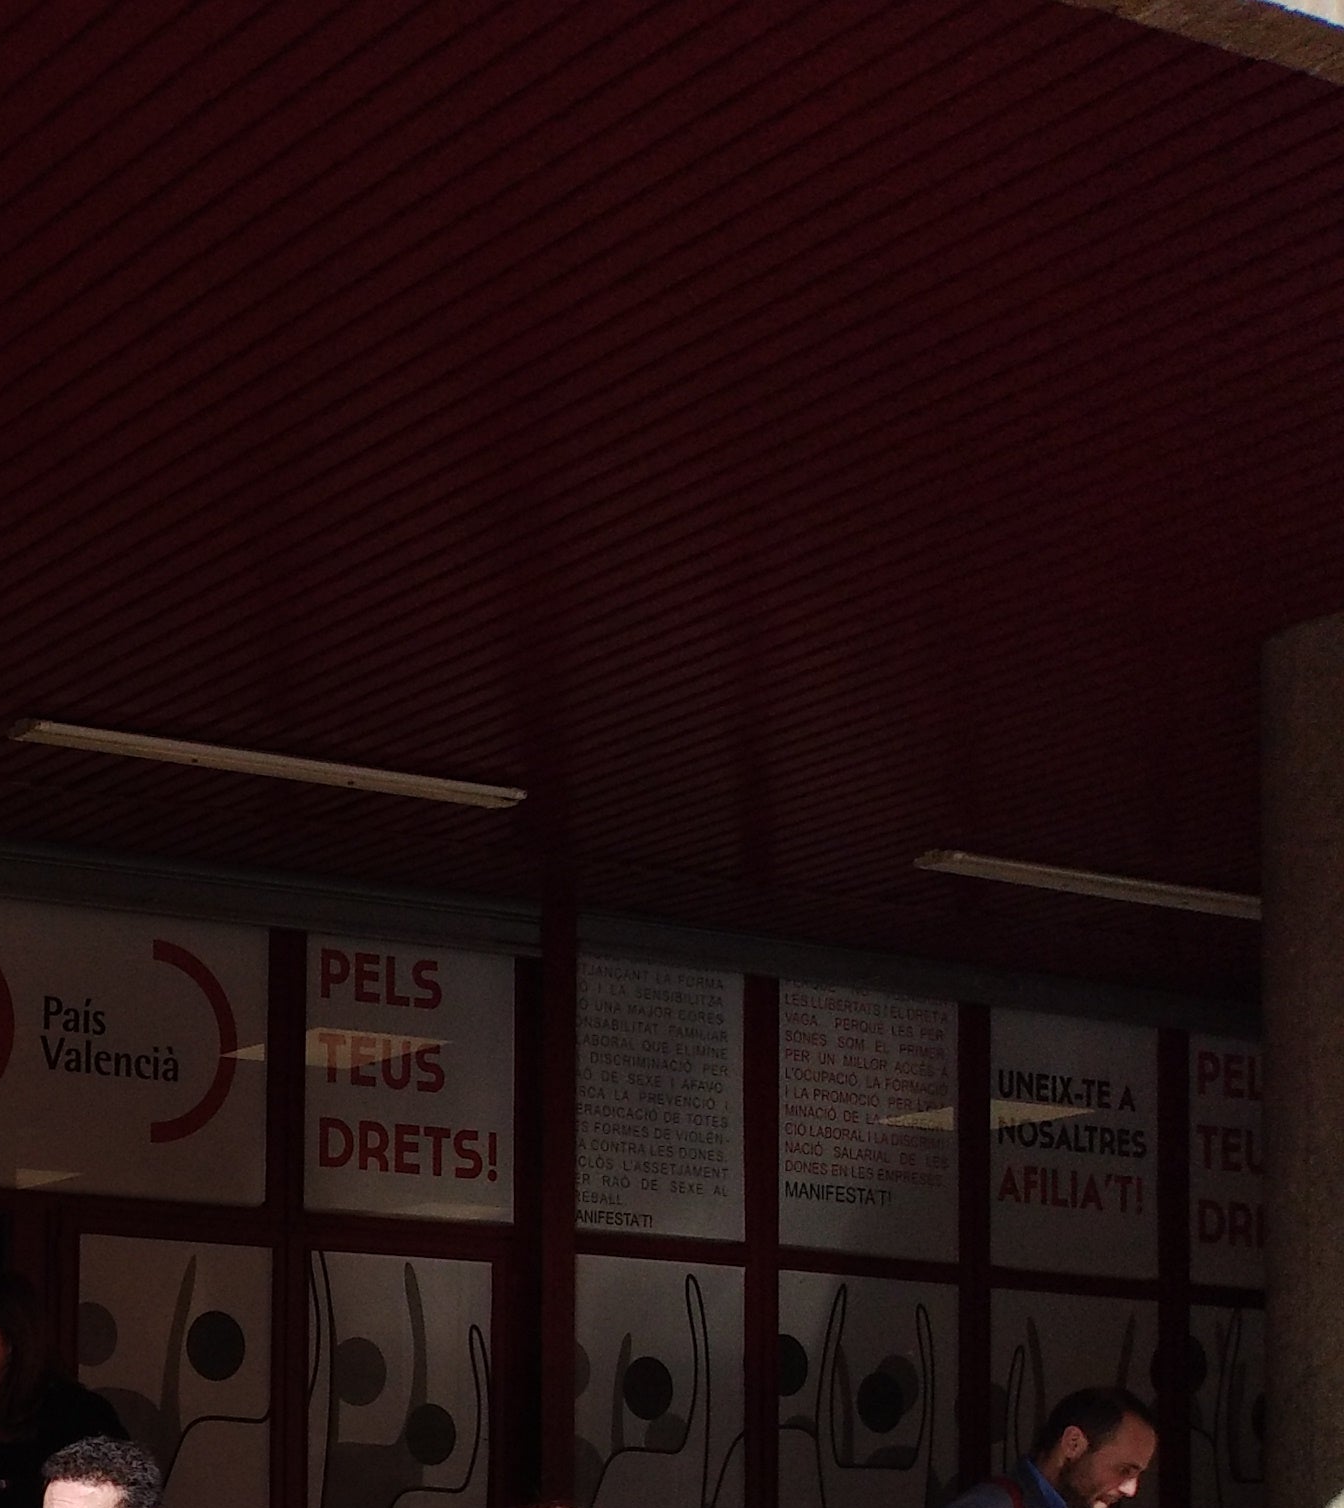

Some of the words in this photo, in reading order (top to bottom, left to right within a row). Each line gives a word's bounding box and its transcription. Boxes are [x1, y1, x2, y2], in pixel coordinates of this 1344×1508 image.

[319, 949, 442, 1010] PELS
[43, 996, 107, 1036] País
[40, 1037, 179, 1083] Valencià
[318, 1033, 446, 1092] TEUS
[998, 1070, 1110, 1109] UNEIX-TE
[1118, 1085, 1136, 1112] A
[318, 1117, 499, 1183] DRETS!
[998, 1118, 1147, 1158] NOSALTRES
